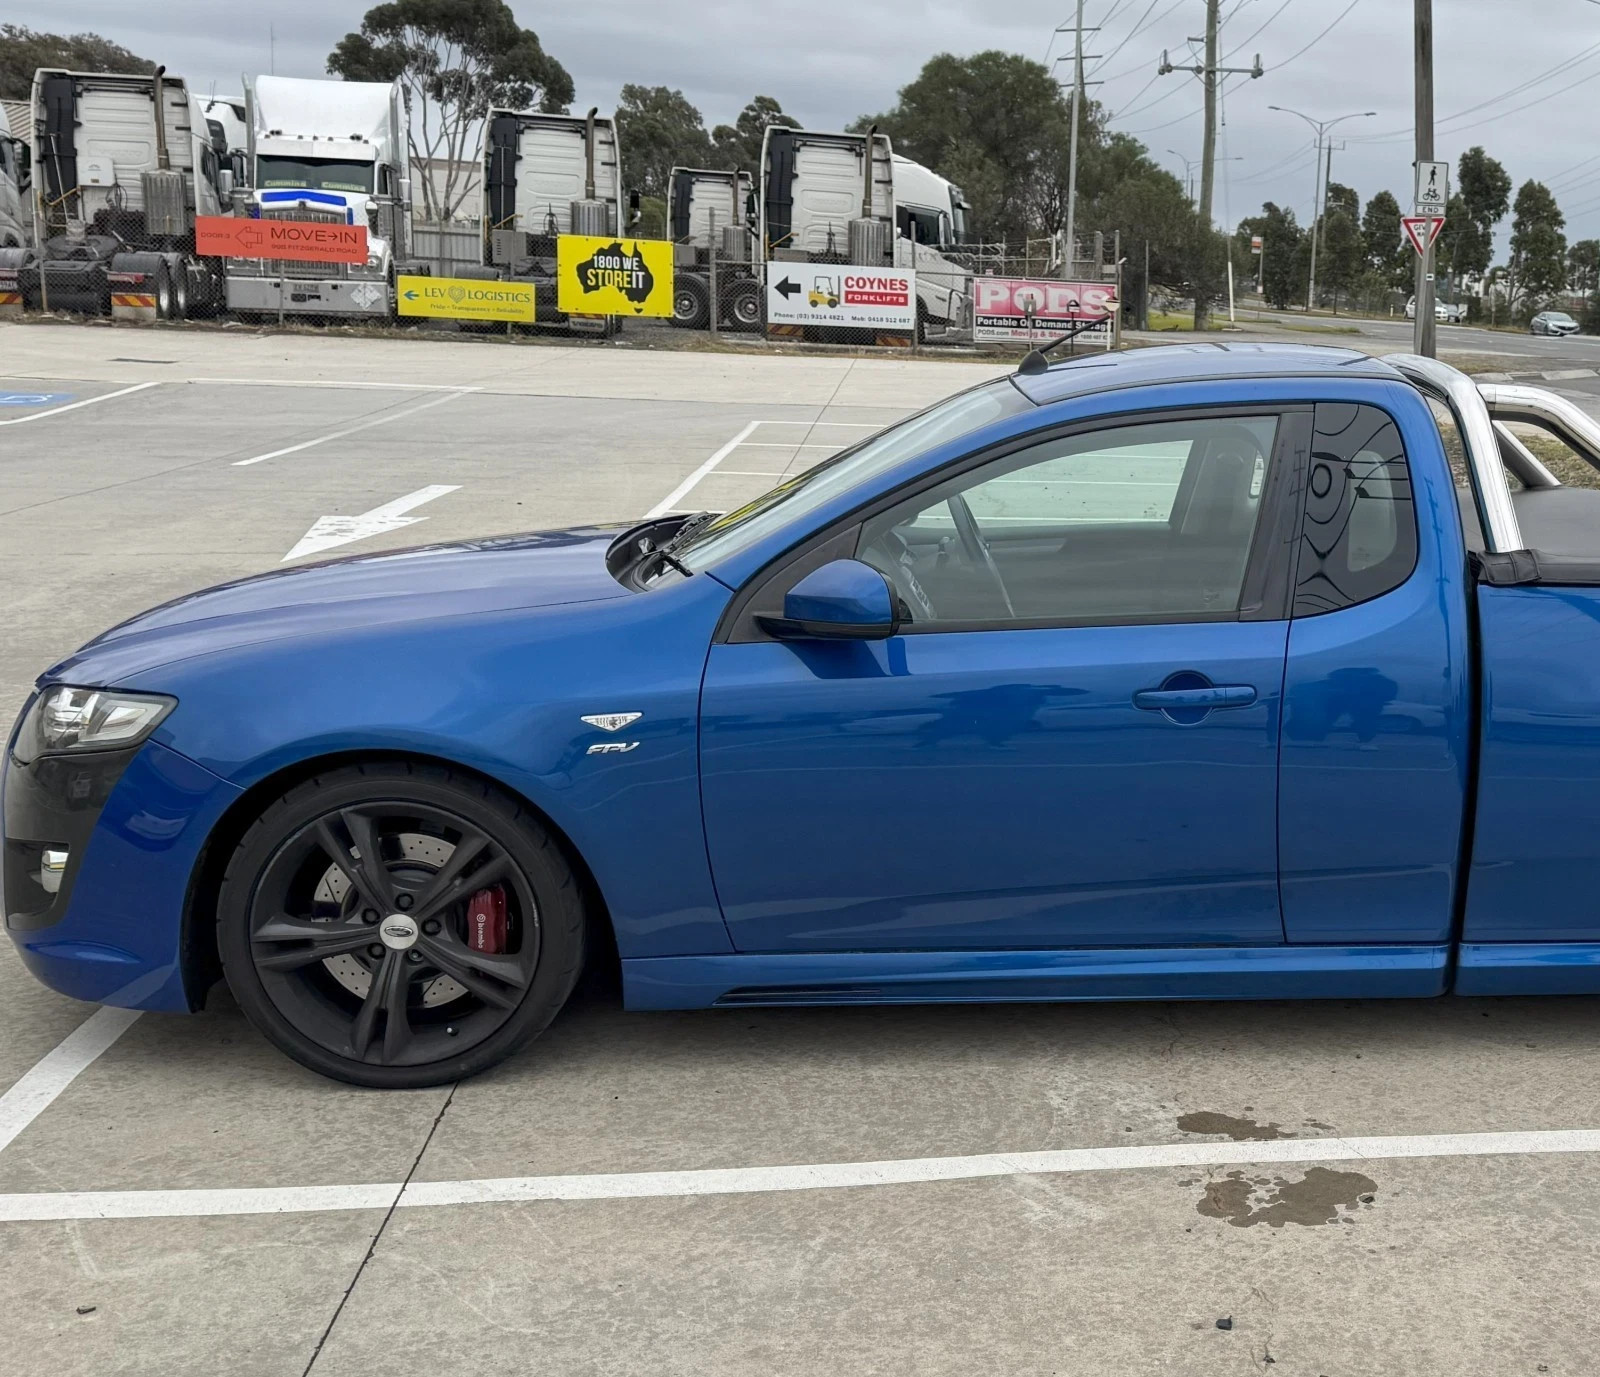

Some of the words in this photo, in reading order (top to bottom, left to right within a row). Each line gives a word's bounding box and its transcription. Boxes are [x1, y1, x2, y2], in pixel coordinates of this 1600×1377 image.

[593, 255, 620, 269] 1800
[622, 256, 640, 270] WE
[844, 276, 909, 291] COYNES
[424, 287, 446, 298] LEV
[467, 290, 530, 303] LOGISTICS
[847, 294, 905, 303] FORKLIFTS
[977, 283, 1109, 315] PODS
[977, 316, 1018, 327] Portable
[1035, 320, 1073, 329] Demand
[1075, 321, 1112, 332] Stag
[586, 742, 640, 755] FPV
[476, 922, 484, 949] brembo
